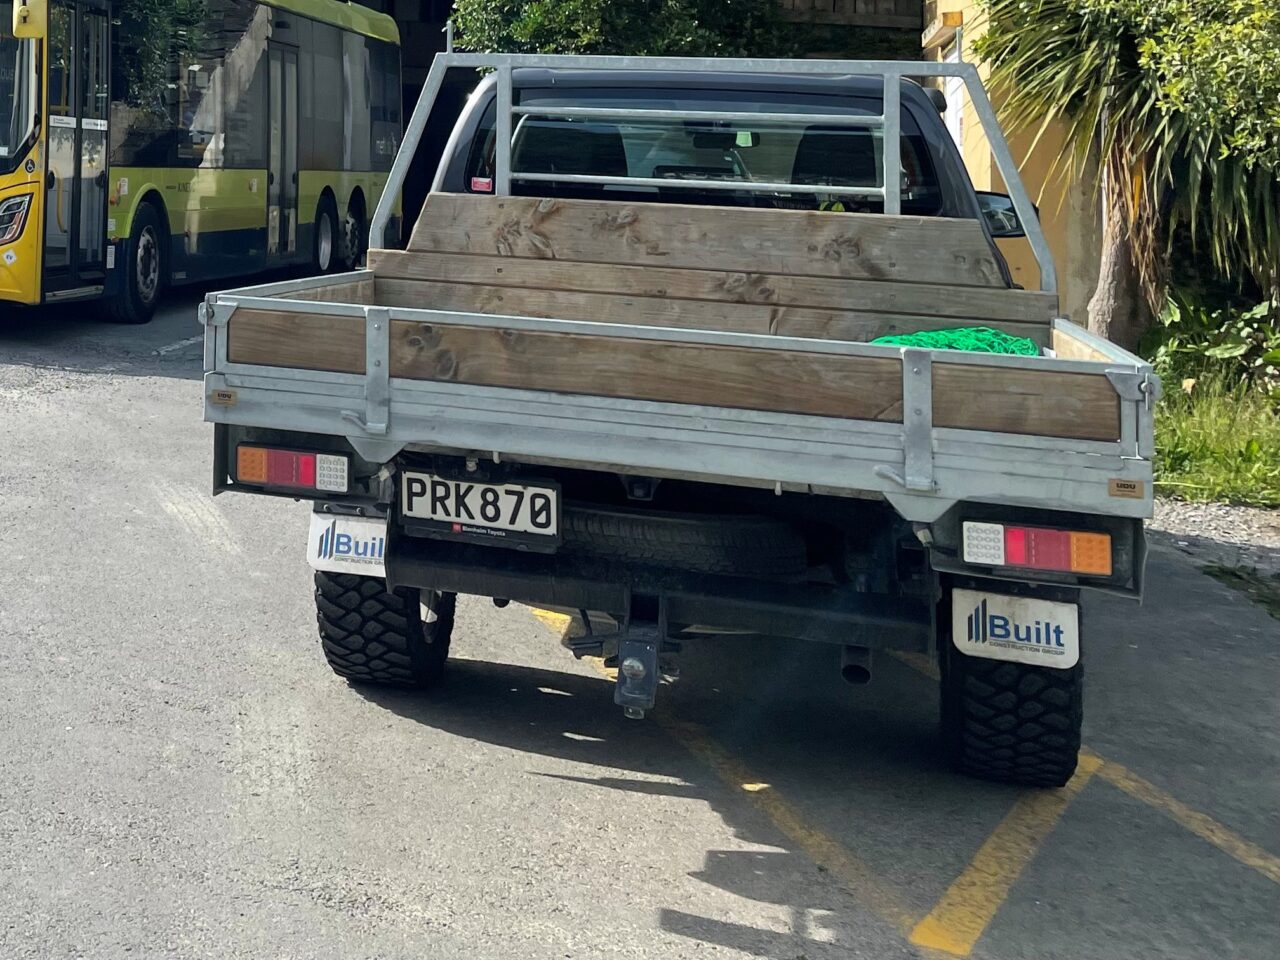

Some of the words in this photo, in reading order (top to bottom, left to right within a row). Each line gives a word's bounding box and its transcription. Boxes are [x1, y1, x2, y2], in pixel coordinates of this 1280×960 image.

[406, 477, 552, 529] PRK870
[462, 525, 487, 533] Blenheim
[488, 528, 505, 536] Toyota
[335, 534, 384, 557] Buil
[989, 615, 1064, 647] Built
[989, 641, 1040, 652] CONSTRUCTION
